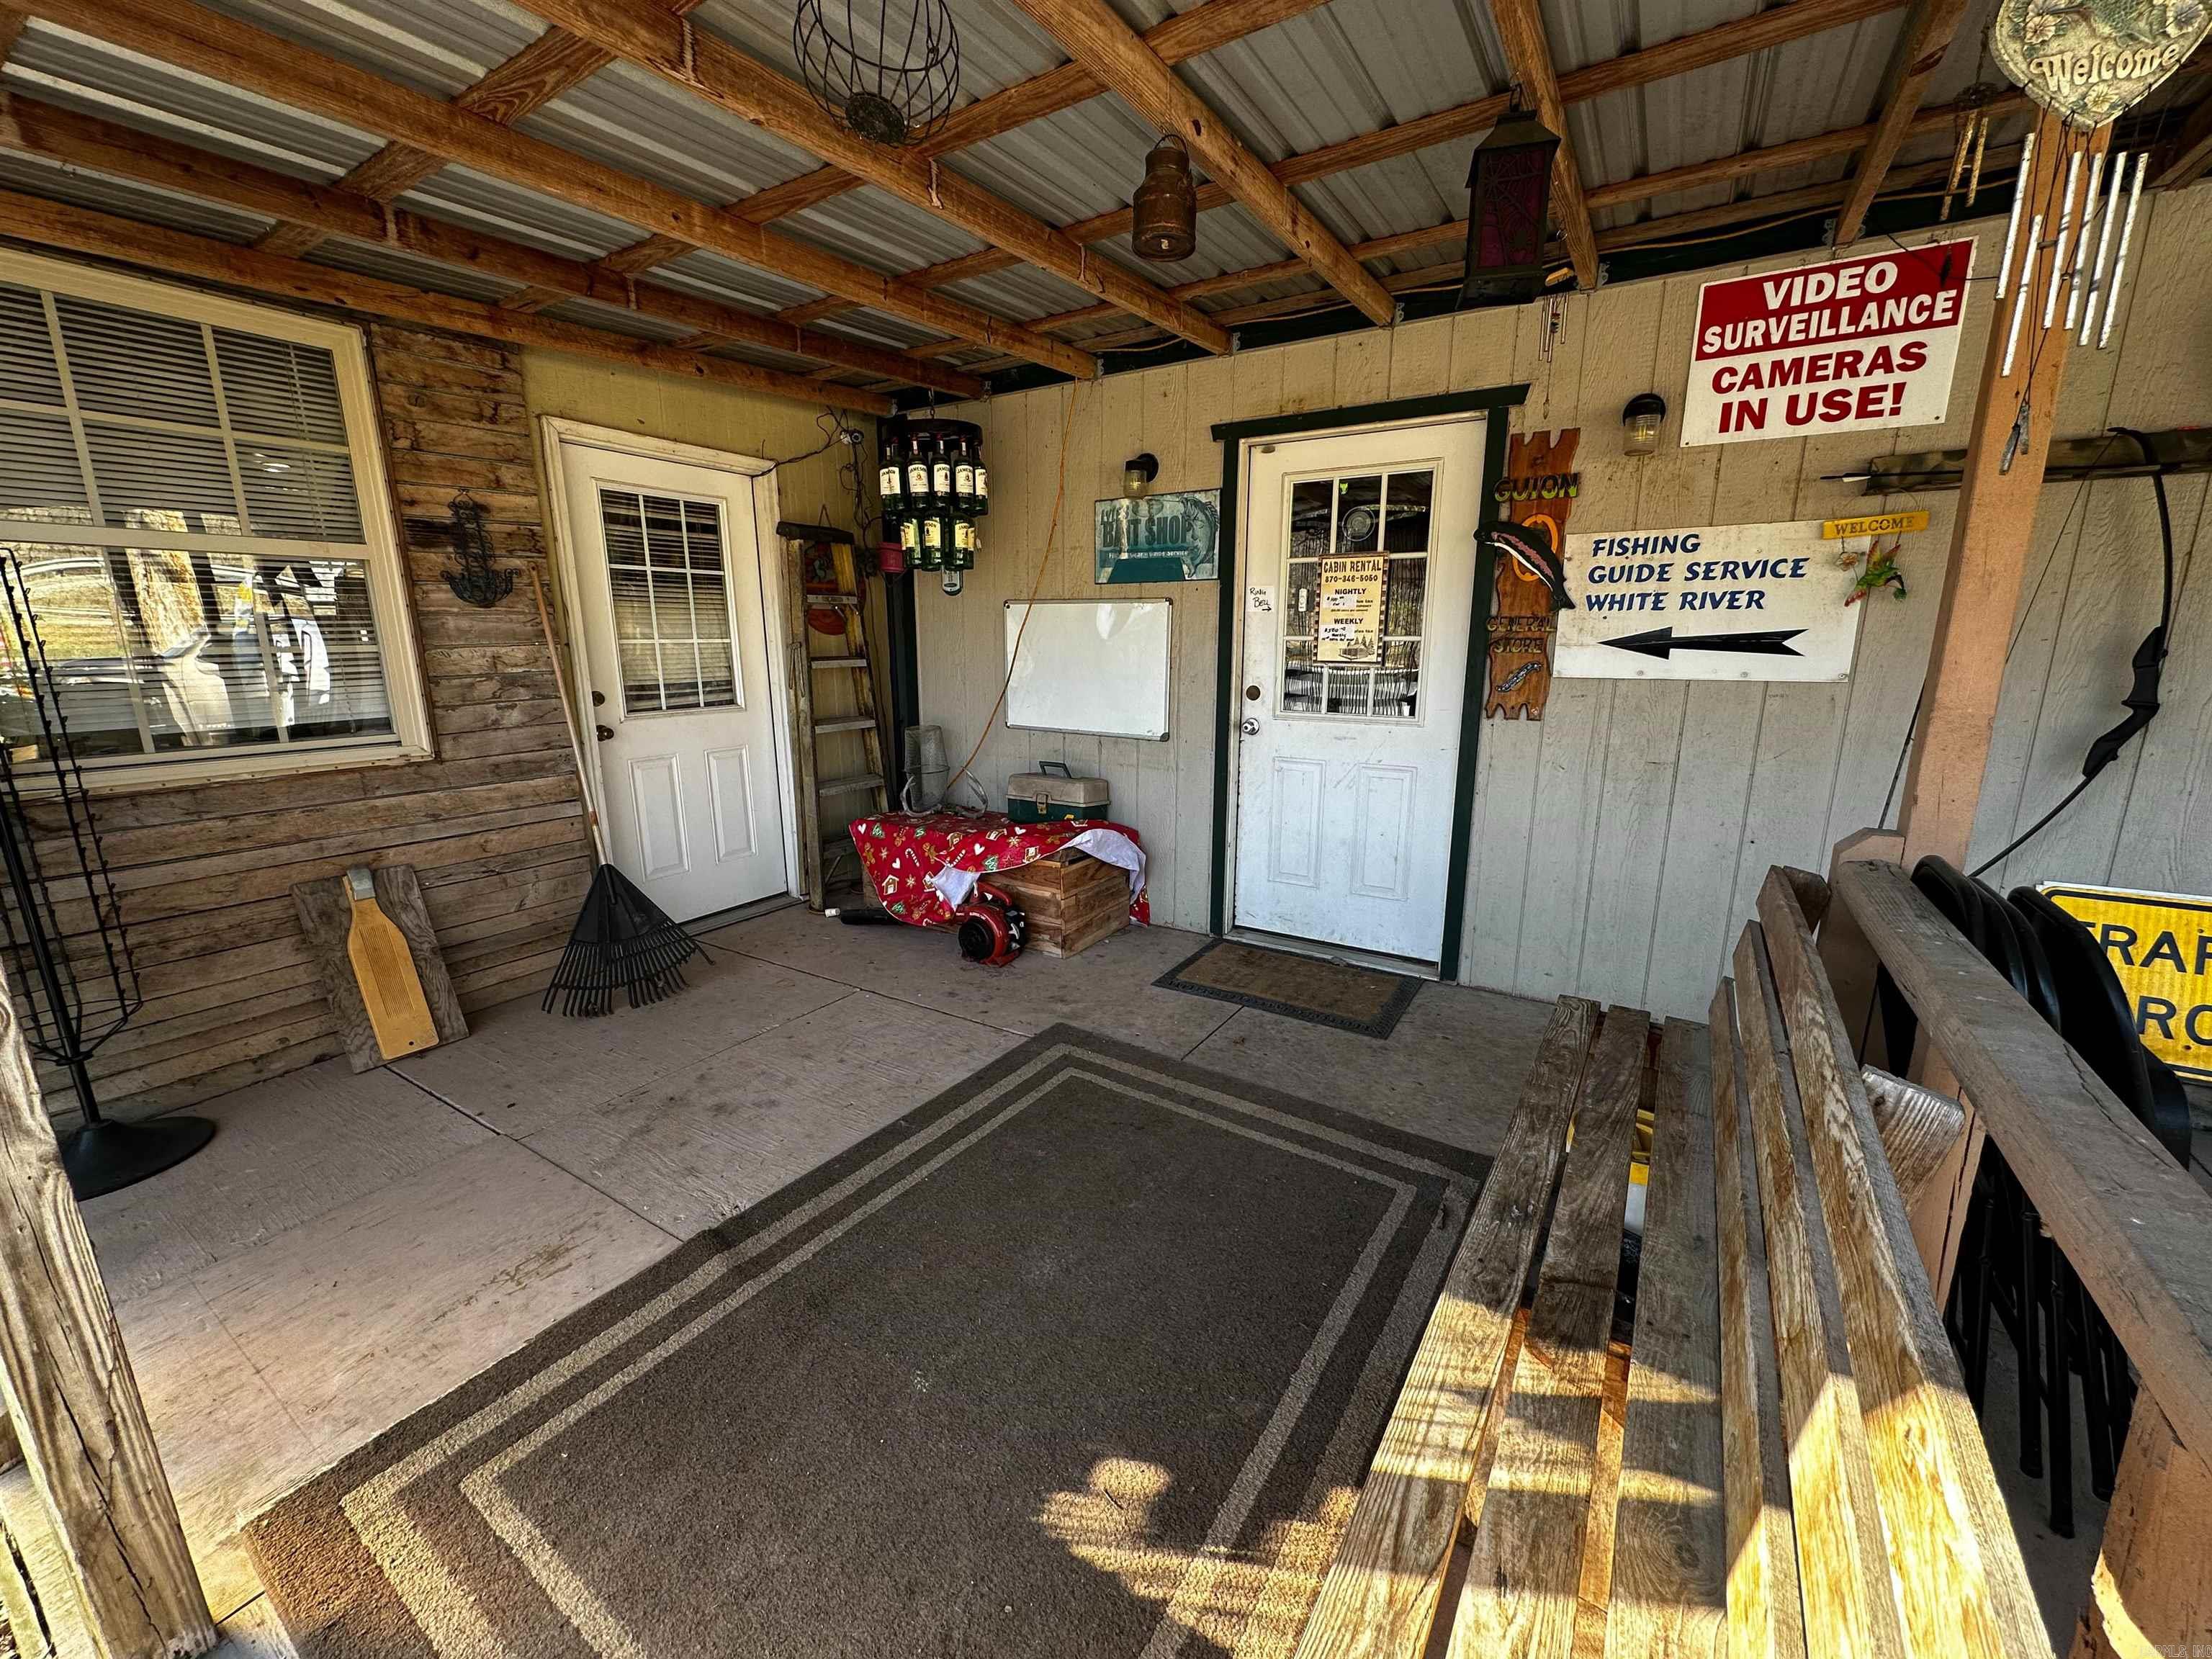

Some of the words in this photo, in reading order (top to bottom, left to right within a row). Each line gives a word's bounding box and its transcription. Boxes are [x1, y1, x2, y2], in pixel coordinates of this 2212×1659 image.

[2029, 43, 2180, 96] Welcome
[1763, 261, 1899, 311] VIDEO
[1701, 289, 1957, 354] SURVEILLANCE
[1712, 341, 1928, 395] CAMERAS
[1718, 397, 1768, 433] IN
[1785, 382, 1907, 426] USE!
[1493, 472, 1578, 502] GUION
[1835, 516, 1914, 535] WELCOME
[1592, 534, 1700, 557] FISHING
[1323, 562, 1346, 573] CABIN
[1349, 559, 1381, 572] RENTAL
[1588, 562, 1674, 584] GUIDE
[1684, 557, 1810, 582] SERVICE
[1586, 592, 1669, 611] WHITE
[1678, 590, 1765, 611] RIVER
[1487, 616, 1557, 631] GENERAL
[1494, 639, 1543, 653] STORE
